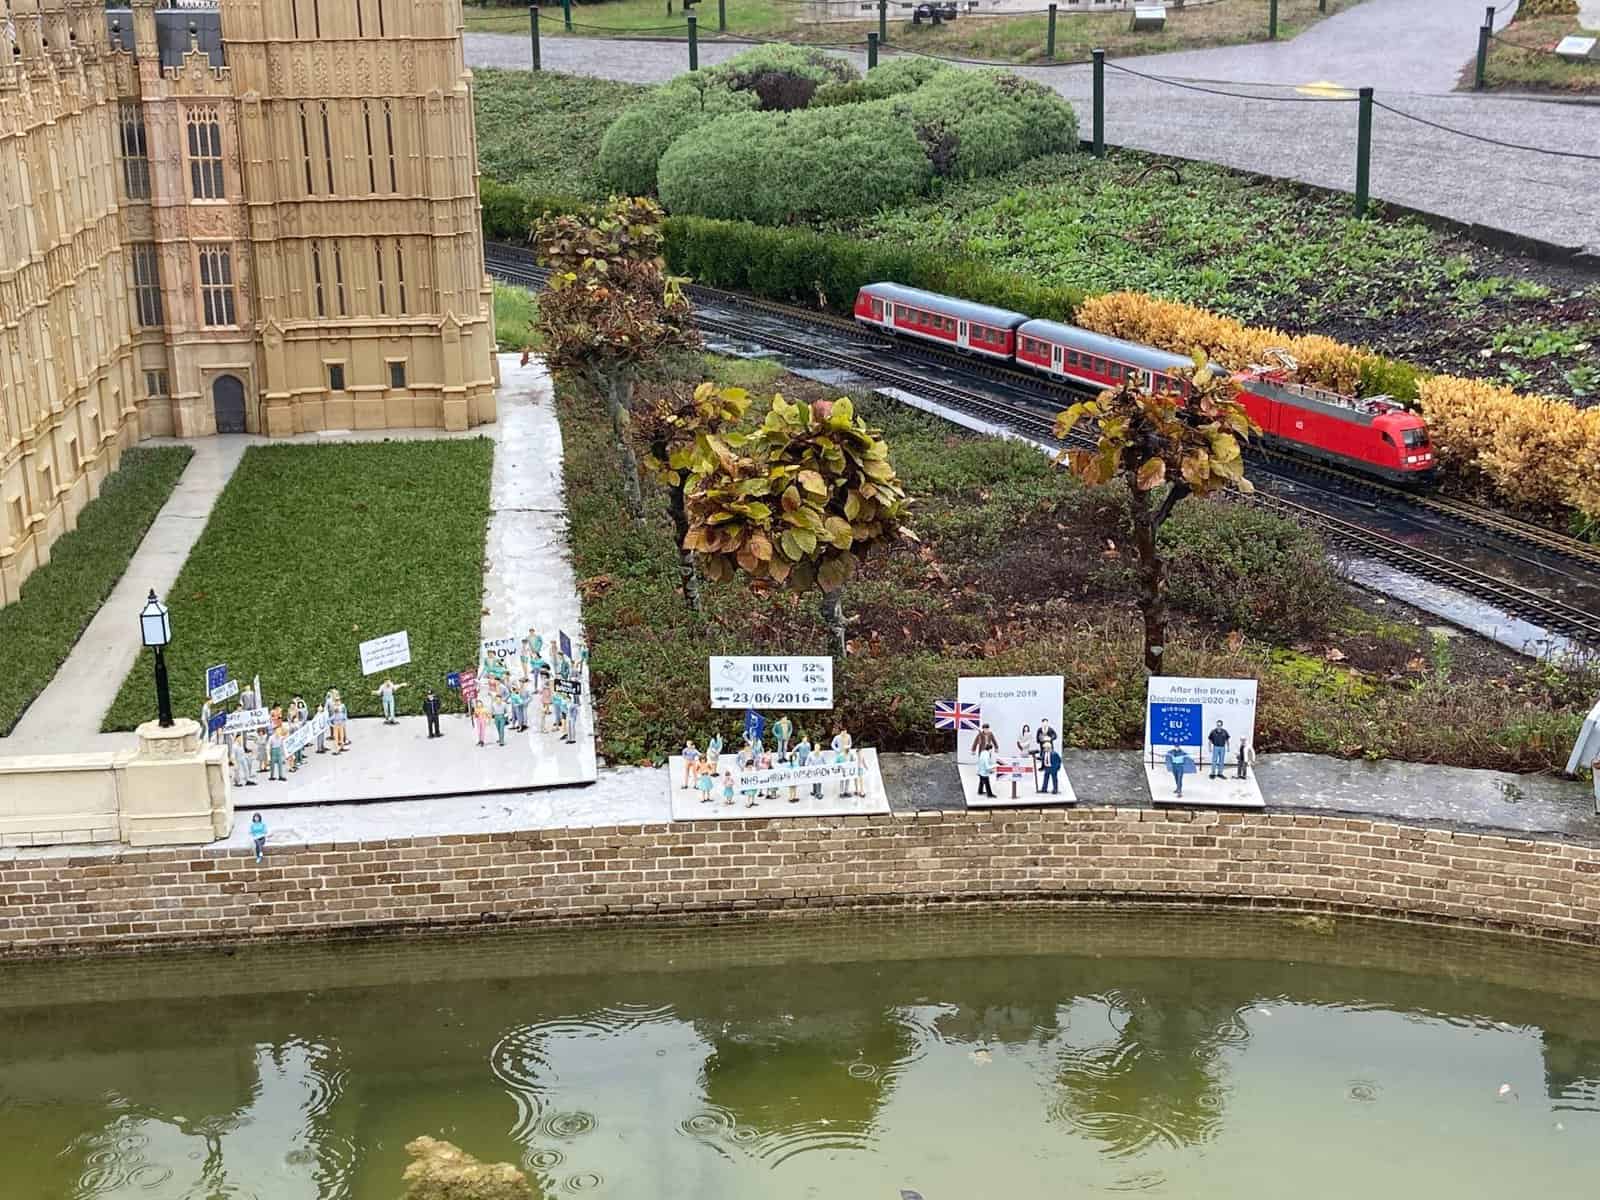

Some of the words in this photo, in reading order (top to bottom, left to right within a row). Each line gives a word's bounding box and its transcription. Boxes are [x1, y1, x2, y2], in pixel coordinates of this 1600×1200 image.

[752, 663, 788, 673] BREXIT
[801, 663, 825, 673] 52%
[752, 674, 790, 683] REMAIN
[802, 674, 826, 683] 48%
[980, 690, 1015, 698] Election
[1016, 690, 1037, 698] 2019
[1170, 685, 1192, 694] After
[1194, 687, 1209, 695] the
[732, 693, 810, 704] 23/06/2016
[1150, 695, 1187, 703] Decision
[1169, 720, 1183, 729] EU
